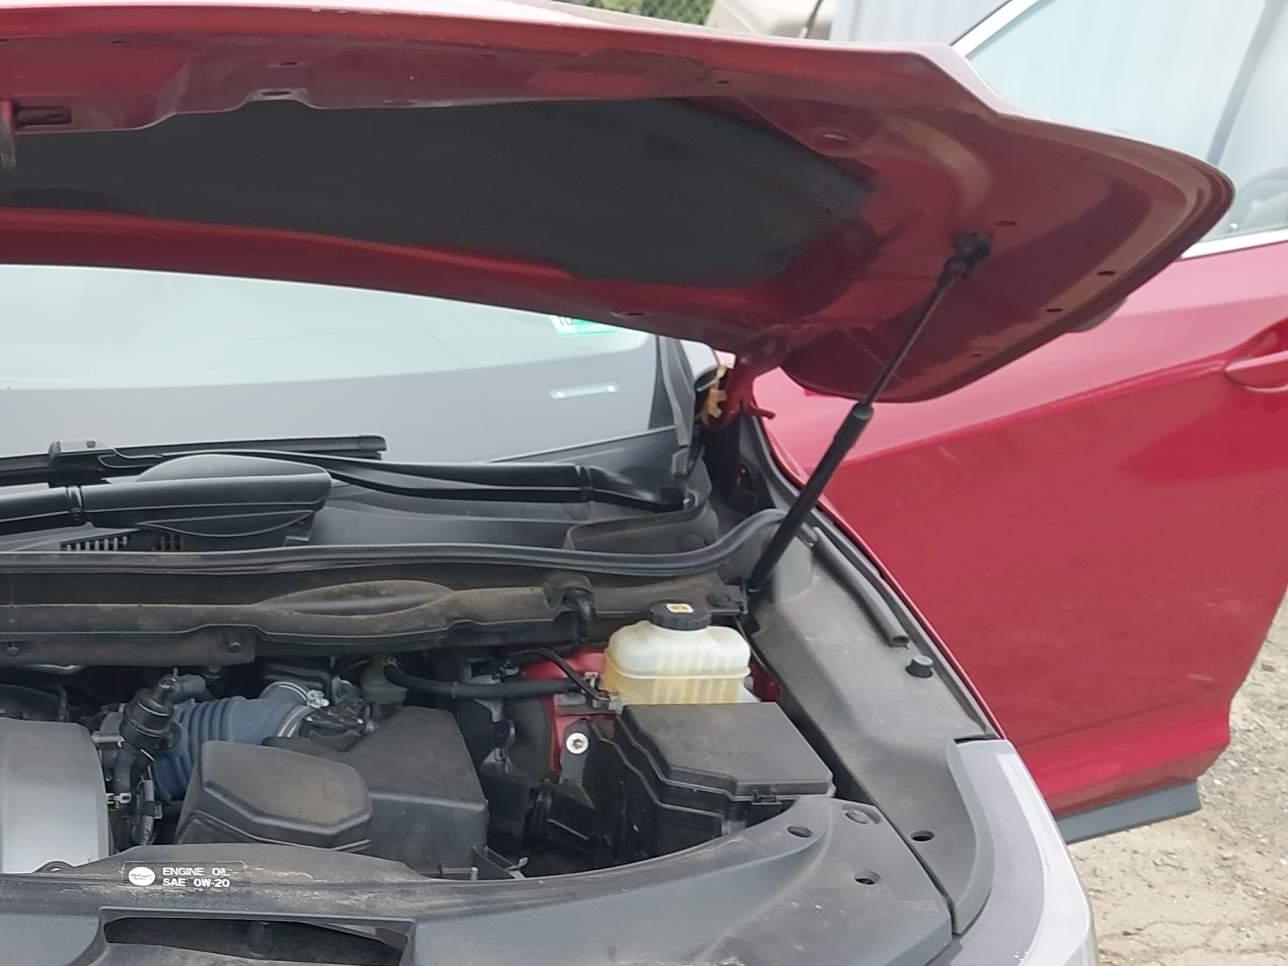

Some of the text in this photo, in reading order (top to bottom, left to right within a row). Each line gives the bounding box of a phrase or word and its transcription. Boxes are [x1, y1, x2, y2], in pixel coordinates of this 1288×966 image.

[162, 867, 204, 876] ENGINE
[162, 878, 230, 888] SAE 0W-20
